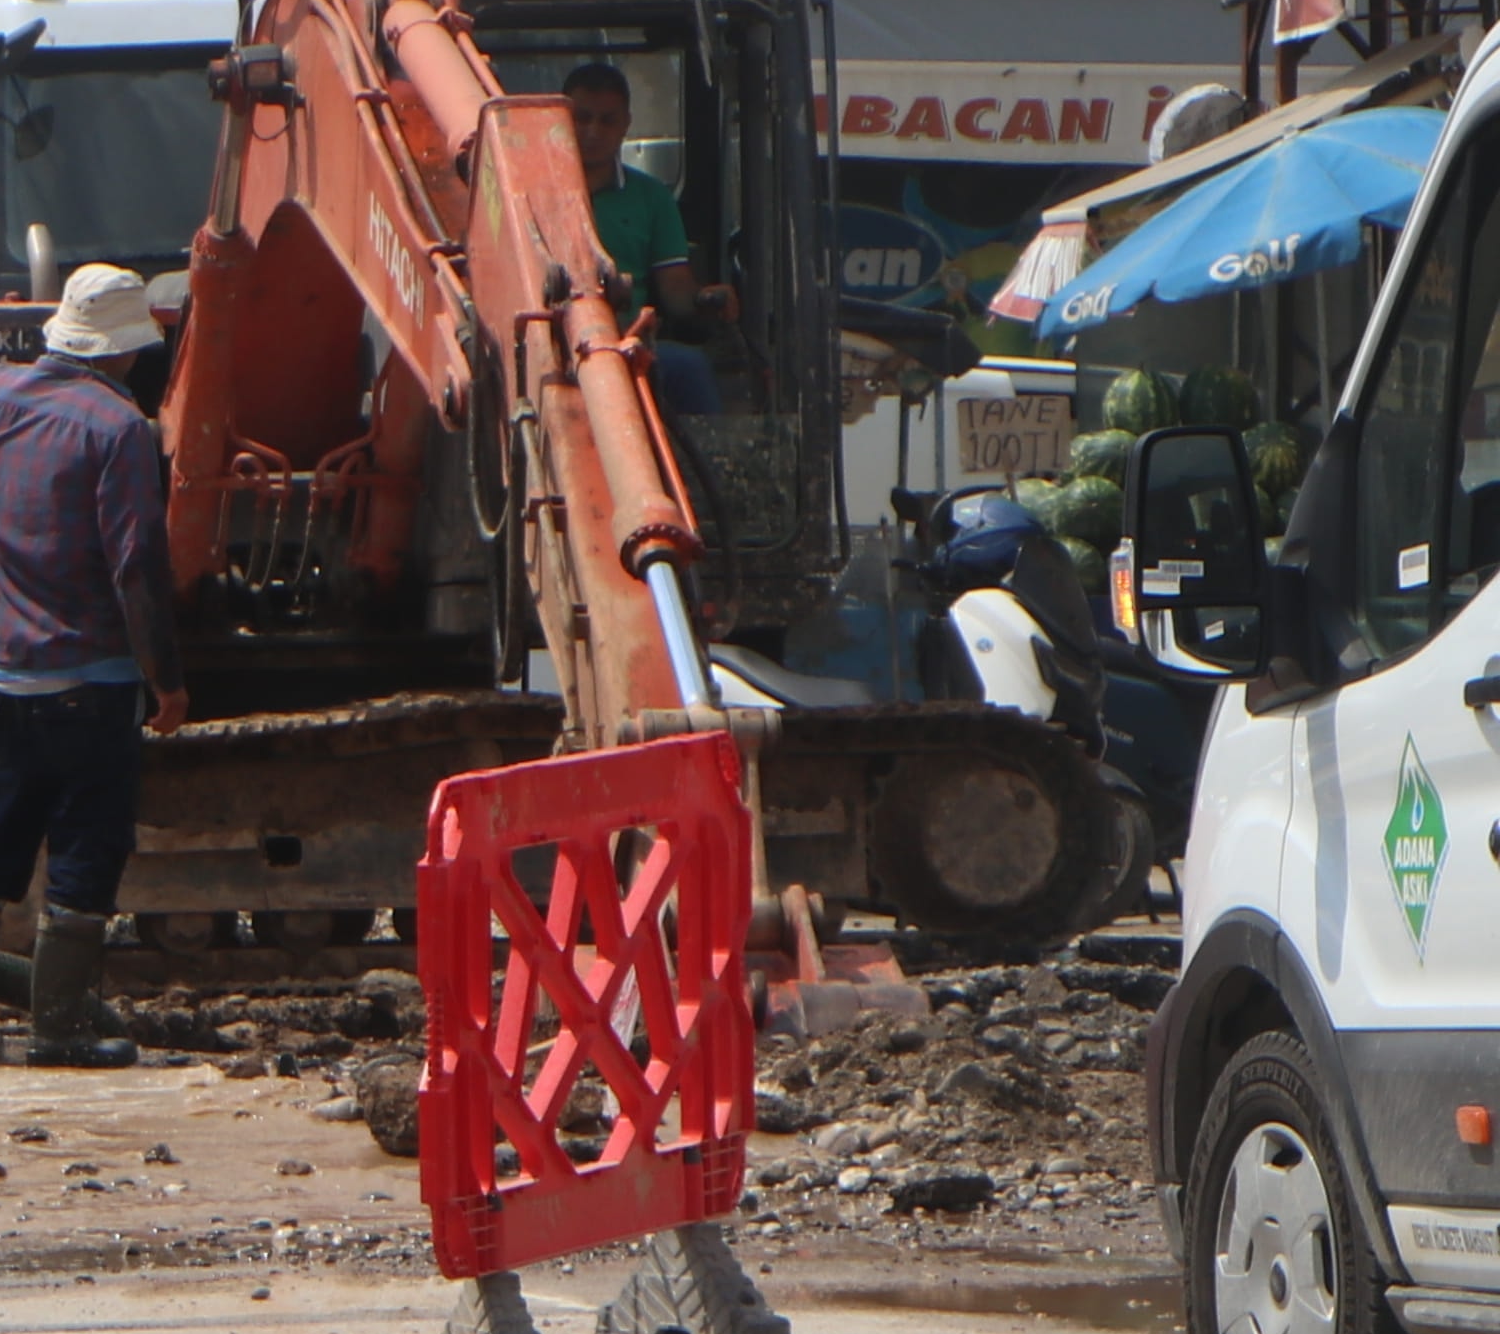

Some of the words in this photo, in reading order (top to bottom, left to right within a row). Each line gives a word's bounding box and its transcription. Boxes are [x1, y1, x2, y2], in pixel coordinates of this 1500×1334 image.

[369, 191, 425, 331] HITACHI
[958, 397, 1058, 429] TANE
[1395, 836, 1436, 868] ADANA
